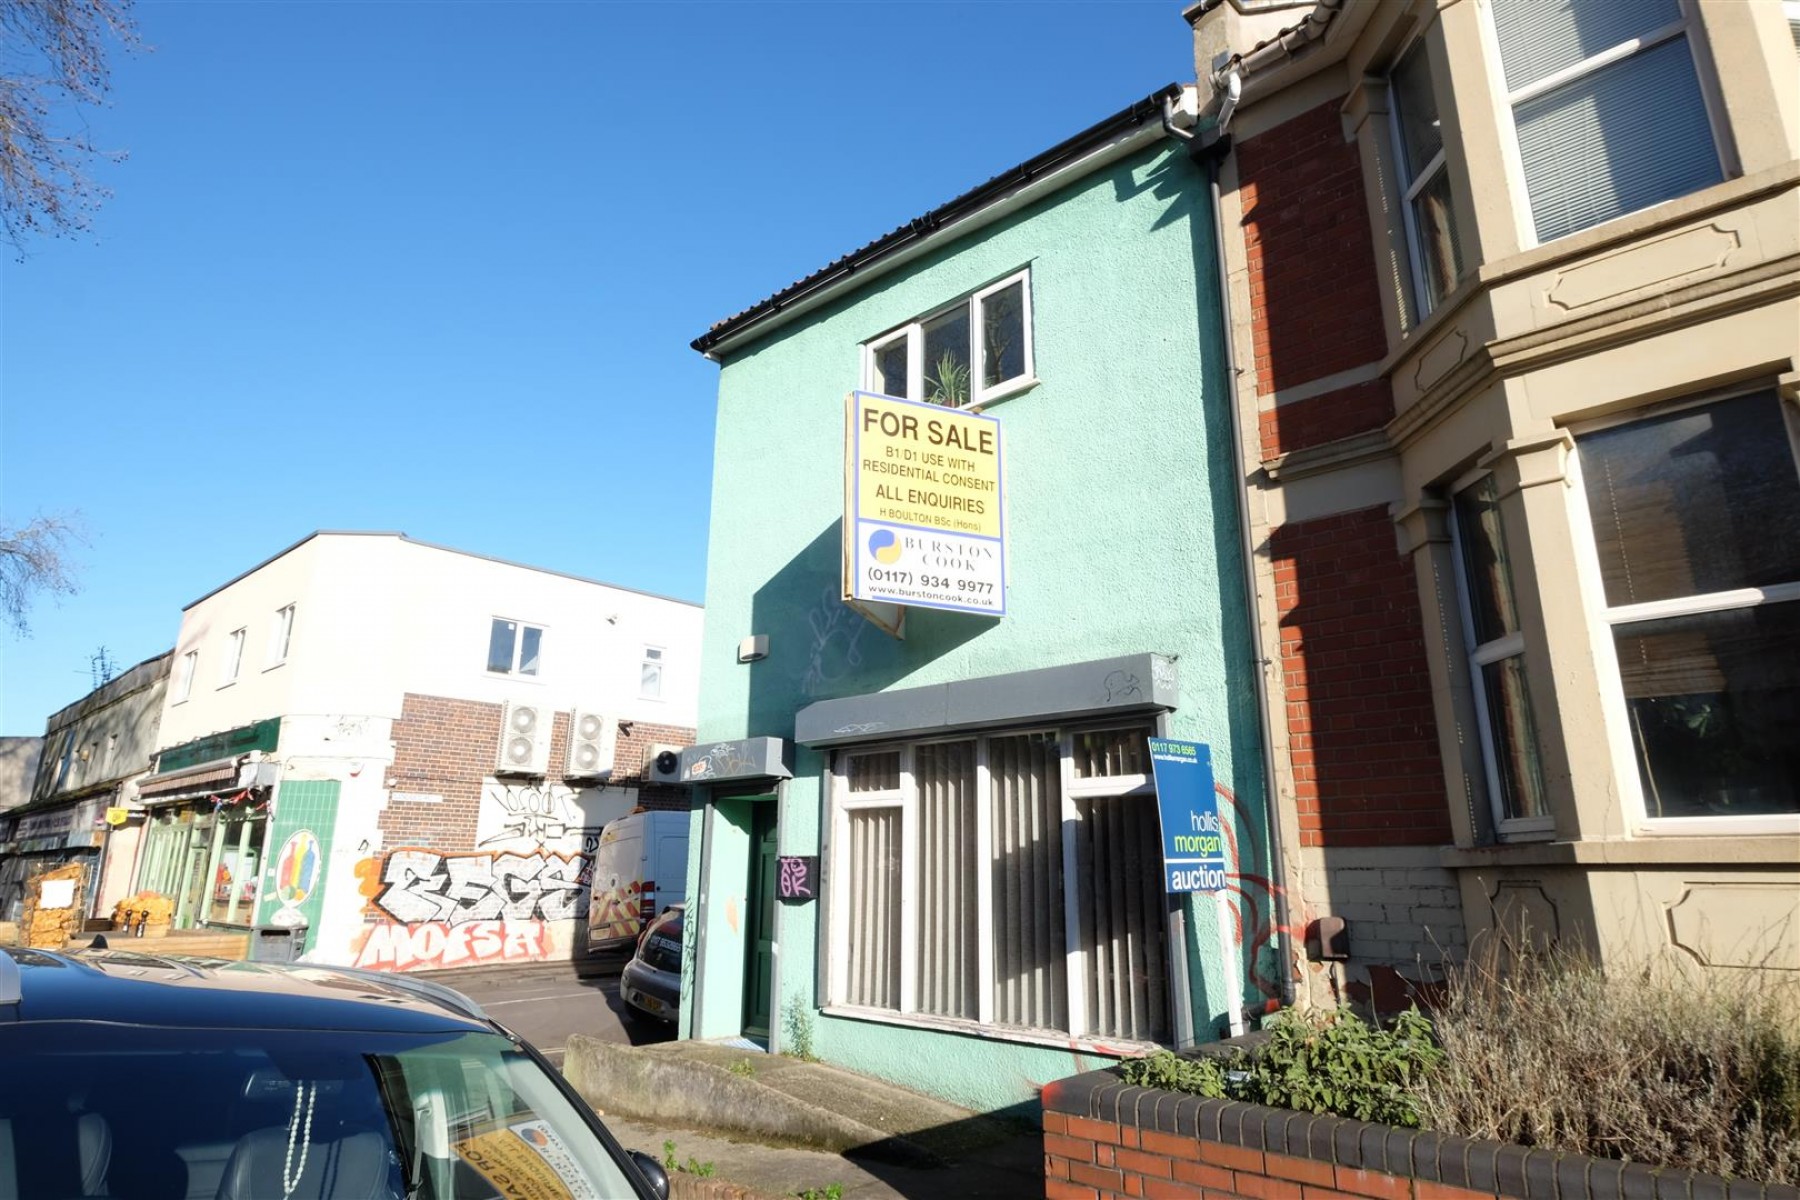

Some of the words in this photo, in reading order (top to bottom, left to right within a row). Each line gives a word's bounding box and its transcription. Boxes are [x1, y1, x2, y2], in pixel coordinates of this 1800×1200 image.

[863, 408, 919, 441] FOR
[927, 420, 994, 455] SALE
[922, 452, 944, 466] USE
[947, 457, 975, 472] WITH
[863, 459, 939, 483] RESIDENTIAL
[943, 473, 995, 492] CONSENT
[876, 484, 903, 501] ALL
[908, 489, 985, 514] ENQUIRIES
[880, 507, 887, 516] H
[889, 508, 932, 524] BOULTON
[934, 515, 951, 527] BSc
[953, 518, 981, 532] (Hons)
[905, 536, 993, 559] BURSTON
[922, 554, 975, 571] COOK
[868, 566, 913, 585] (0117)
[920, 574, 950, 589] 934
[958, 579, 994, 595] 9977
[868, 584, 994, 607] www.burstoncook.co.uk
[1151, 742, 1167, 752] 0117
[1168, 743, 1181, 754] 973
[1191, 810, 1219, 832] hollis
[1174, 835, 1221, 858] morgan
[1172, 865, 1226, 891] auction
